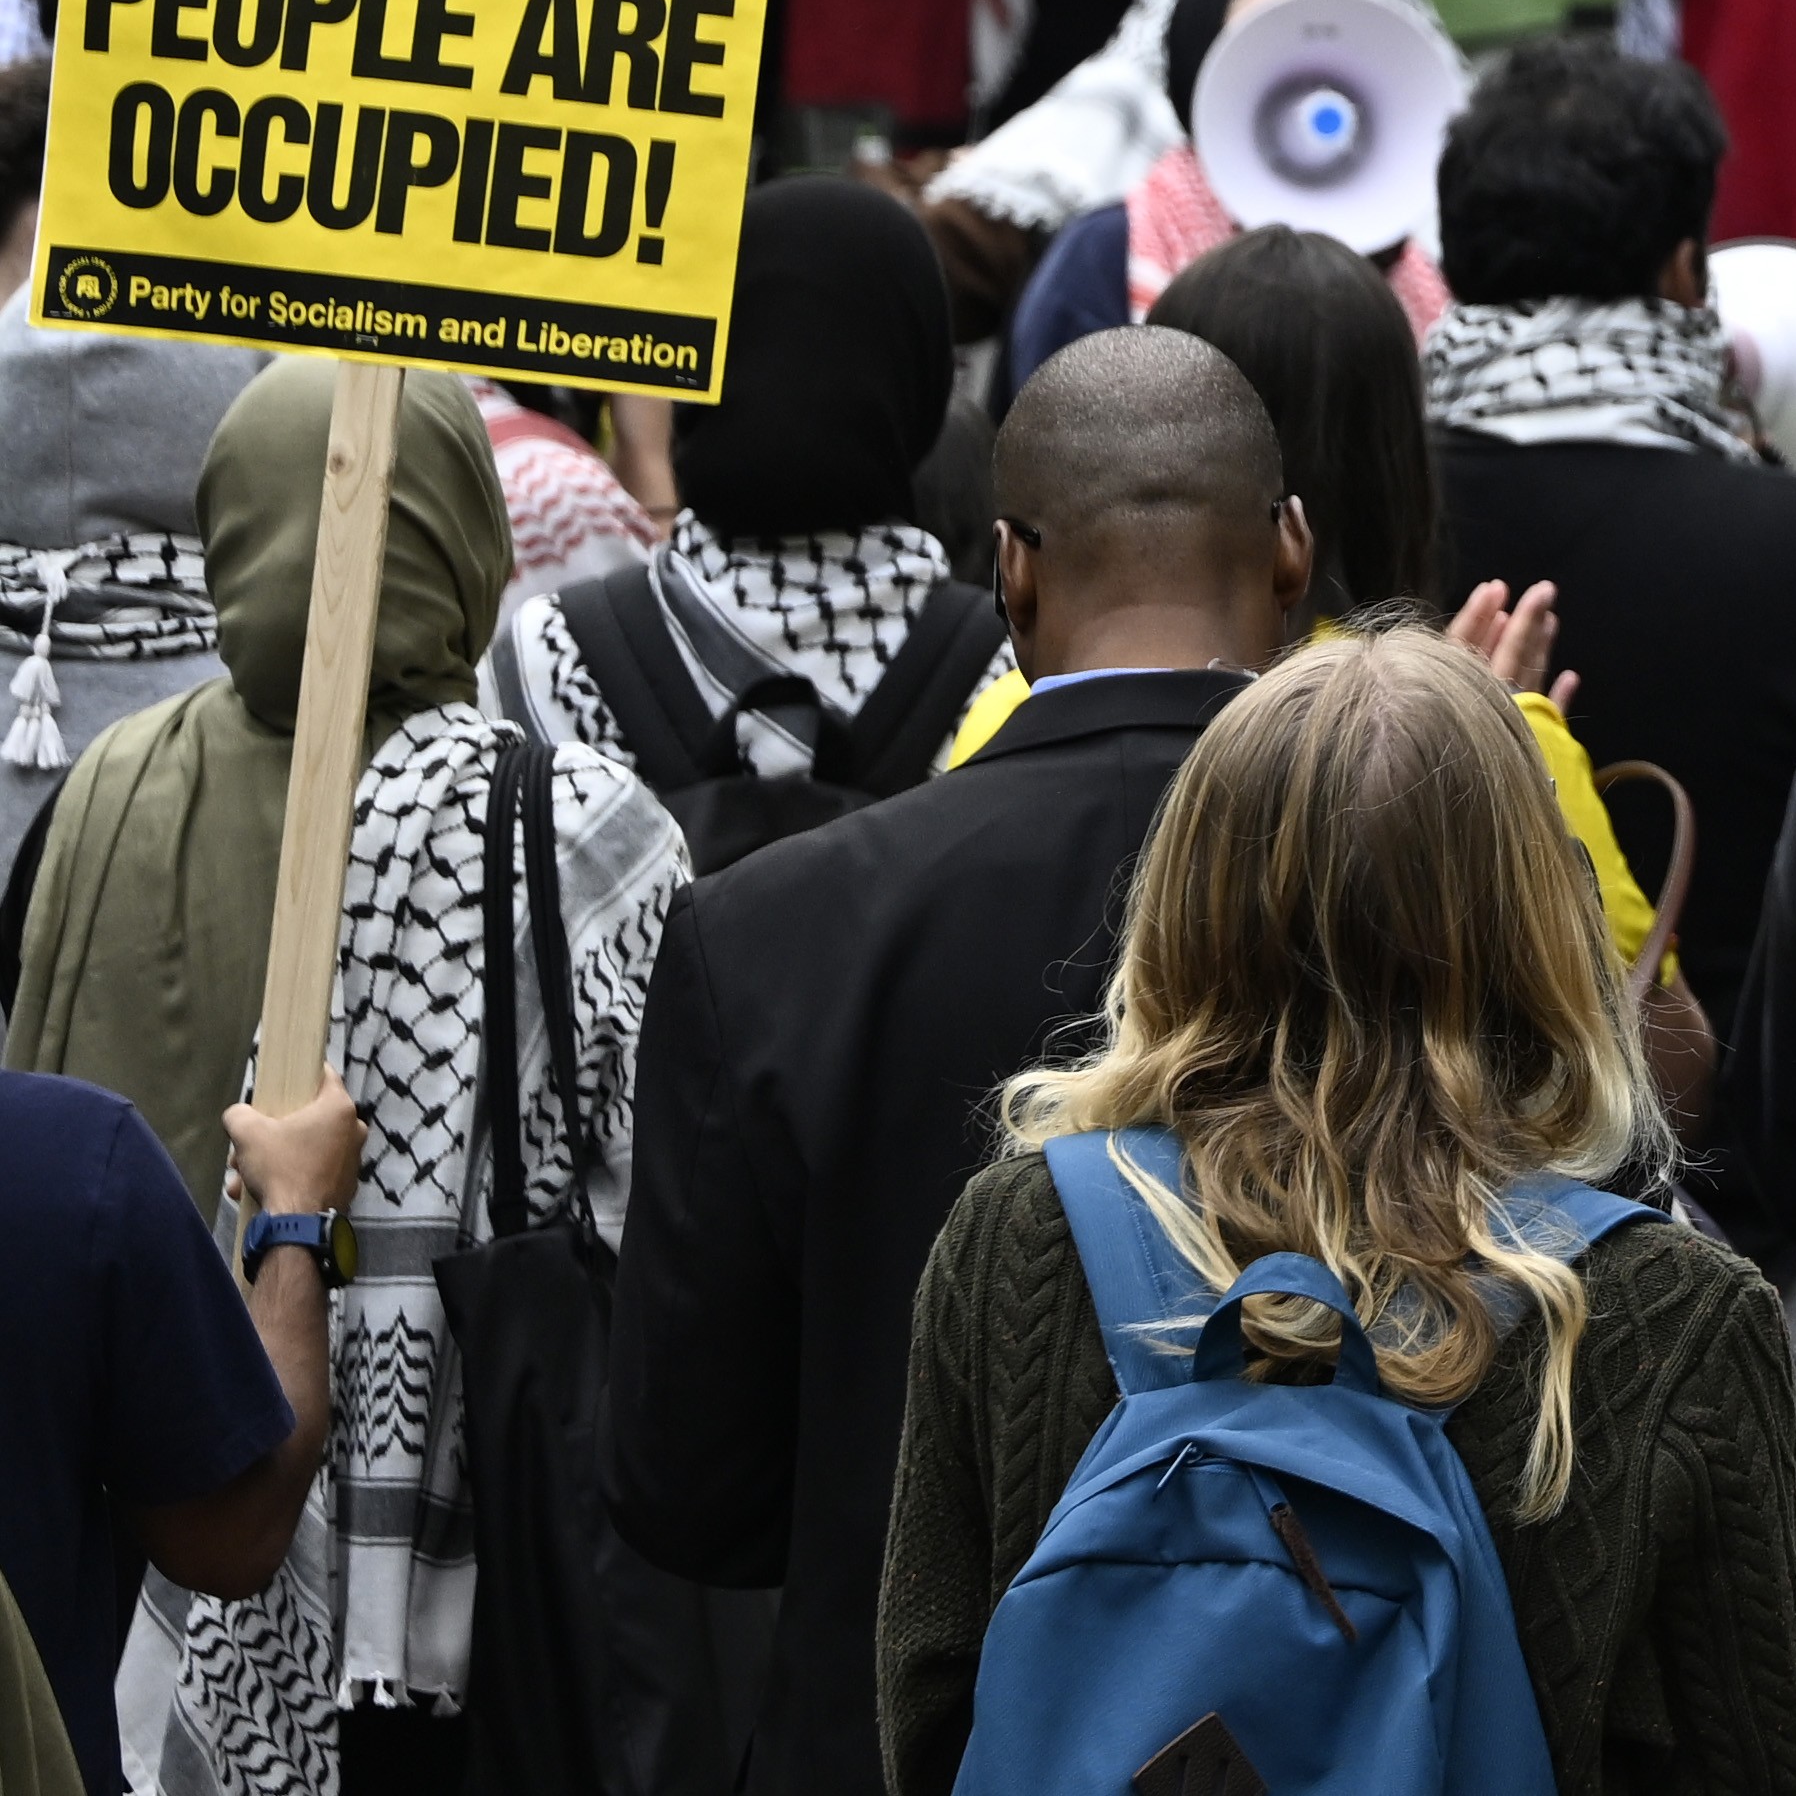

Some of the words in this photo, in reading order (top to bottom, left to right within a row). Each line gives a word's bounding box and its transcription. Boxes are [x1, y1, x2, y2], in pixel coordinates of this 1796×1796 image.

[108, 81, 675, 265] OCCUPIED!
[129, 276, 211, 321] Party
[219, 285, 261, 320] for
[268, 290, 428, 340] Socialism
[438, 316, 507, 349] and
[516, 319, 698, 371] Liberation
